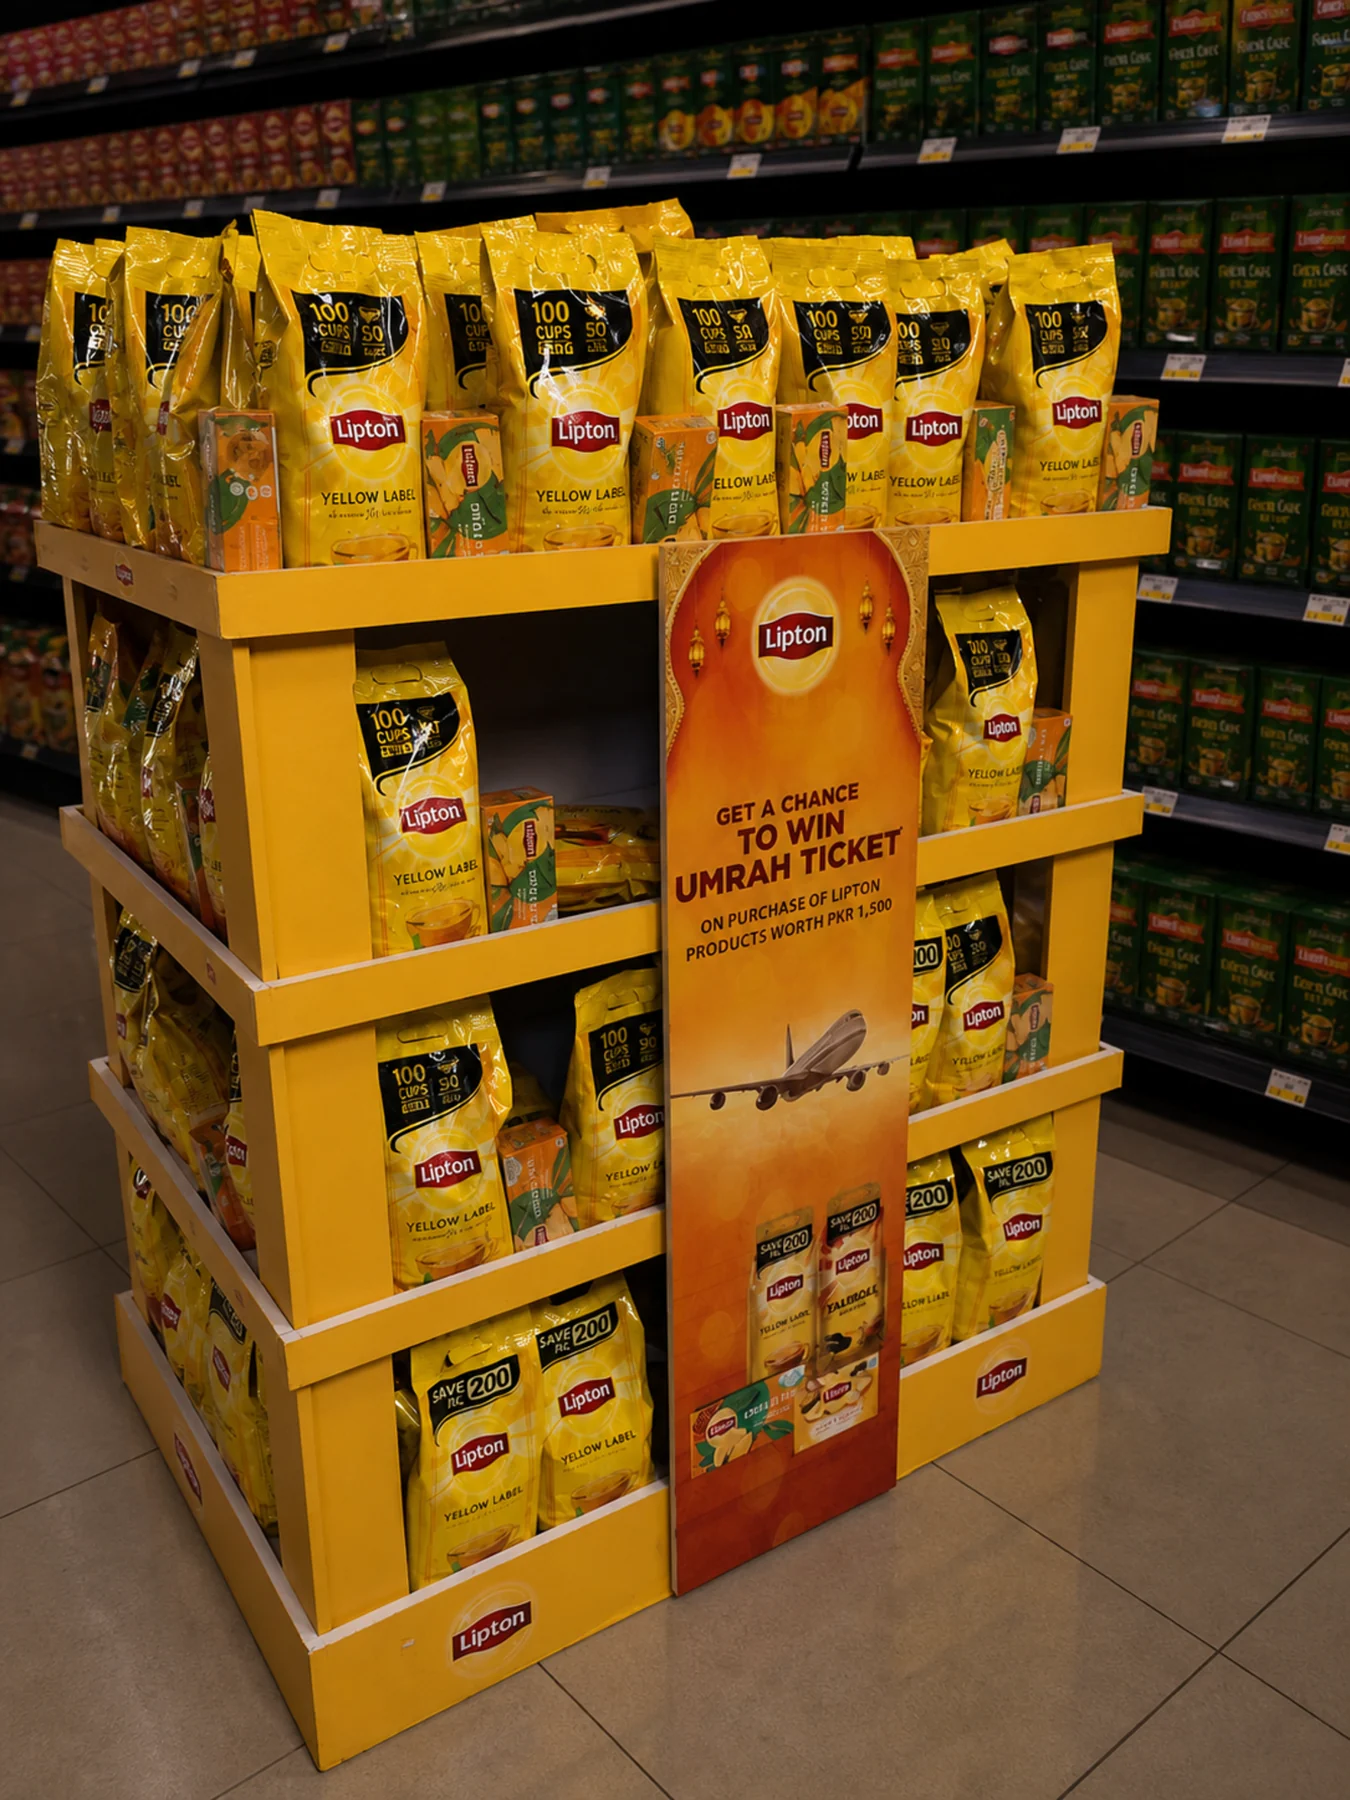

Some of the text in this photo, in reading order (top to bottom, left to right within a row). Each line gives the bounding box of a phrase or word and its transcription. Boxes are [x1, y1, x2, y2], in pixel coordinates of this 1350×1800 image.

[309, 302, 349, 322] 100
[531, 301, 569, 323] 100
[692, 308, 721, 326] 100
[806, 309, 837, 327] 100
[1035, 311, 1061, 328] 100
[318, 325, 350, 340] CUPS
[536, 325, 572, 339] CUPS
[585, 322, 607, 337] 50
[700, 328, 726, 340] CUPS
[898, 322, 920, 339] 00
[723, 412, 770, 433] Lipton
[1057, 404, 1099, 422] Lipton
[337, 420, 399, 442] Lipton
[559, 420, 615, 444] Lipton
[911, 420, 959, 437] Lipton
[1040, 460, 1079, 471] YELLOW
[713, 475, 752, 489] ELLOW
[890, 477, 937, 488] YELLOW
[321, 488, 416, 505] YELLOW LABEL
[536, 489, 590, 502] YELLOW
[766, 625, 827, 651] Lipton
[370, 708, 411, 729] 100
[988, 720, 1017, 736] Lipton
[376, 726, 411, 745] CUPS
[717, 783, 859, 825] GET A CHANCE
[403, 803, 461, 830] Lipton
[738, 810, 844, 855] TO WIN
[393, 859, 478, 885] YELLOW LABEL
[676, 853, 790, 903] UMRAH
[701, 878, 880, 934] ON PURCHASE OF LIPTON
[686, 898, 892, 962] PRODUCTS WORTH PKR 1,500
[913, 943, 936, 964] 00
[966, 1005, 1001, 1026] Lipton
[600, 1026, 628, 1046] 100
[392, 1063, 426, 1084] 100
[398, 1083, 428, 1097] CUPS
[420, 1156, 475, 1183] Lipton
[606, 1165, 650, 1181] YELLOW
[987, 1158, 1044, 1182] SAVE 200
[912, 1188, 946, 1207] 200
[406, 1202, 495, 1233] YELLOW LABEL
[853, 1204, 877, 1223] 200
[1006, 1217, 1040, 1237] Lipton
[784, 1232, 808, 1251] 200
[838, 1253, 869, 1270] Lipton
[769, 1278, 802, 1297] Lipton
[539, 1313, 608, 1348] SAVE 200
[432, 1366, 510, 1404] SAVE 200
[981, 1363, 1023, 1390] Lipton
[563, 1383, 610, 1412] Lipton
[455, 1438, 504, 1467] Lipton
[561, 1431, 636, 1465] YELLOW LABEL
[444, 1486, 523, 1521] YELLOW LABEL
[460, 1610, 525, 1651] Lipton
